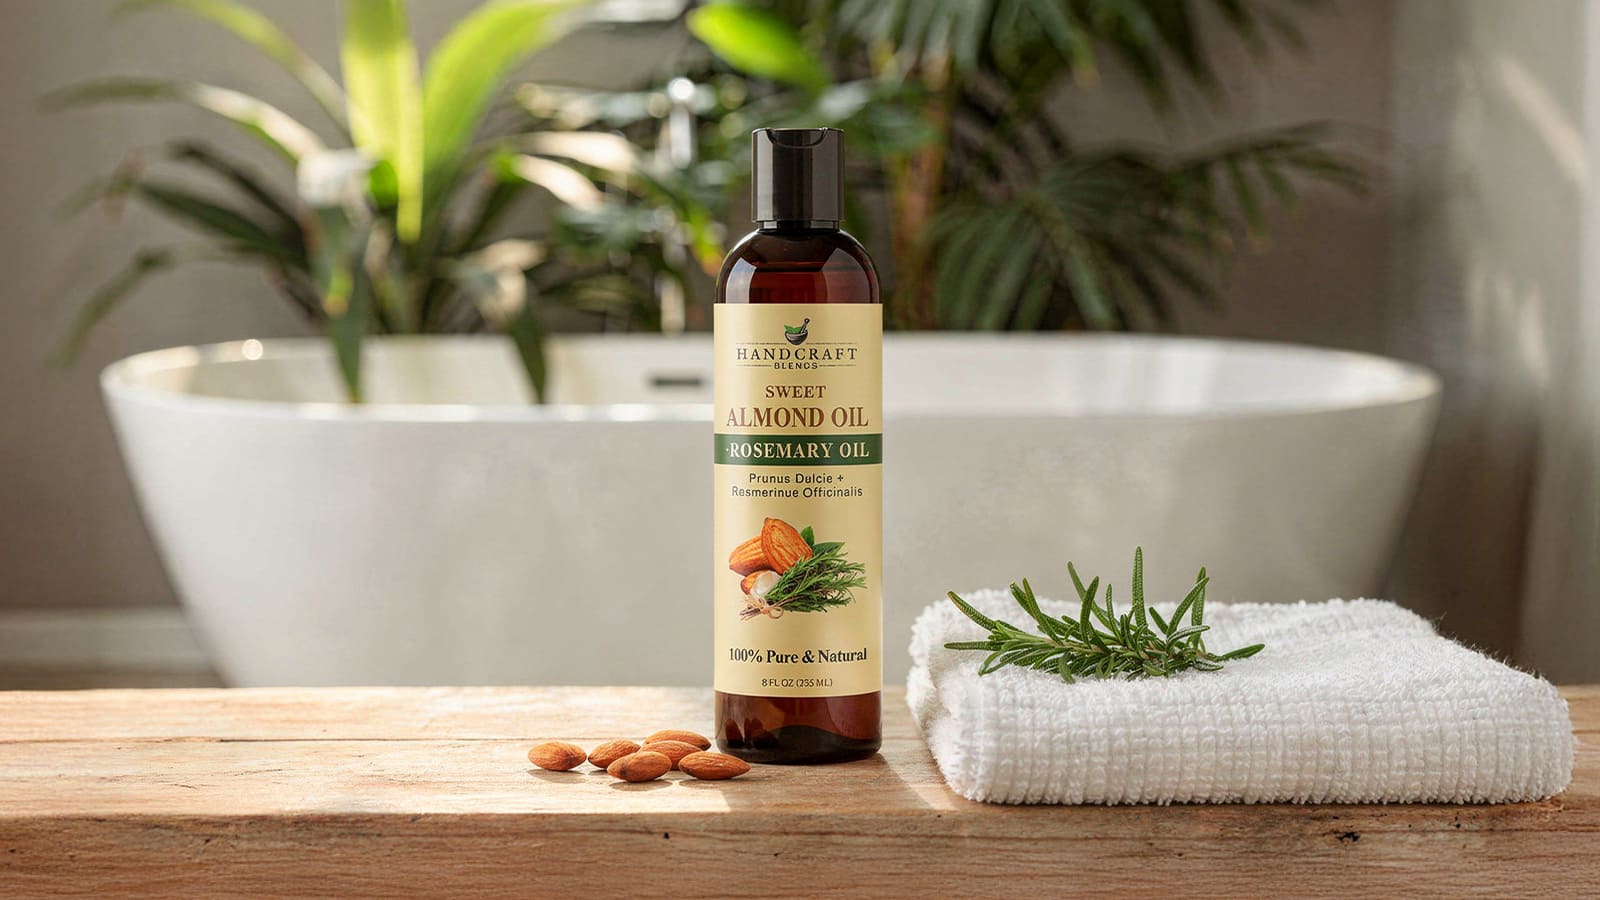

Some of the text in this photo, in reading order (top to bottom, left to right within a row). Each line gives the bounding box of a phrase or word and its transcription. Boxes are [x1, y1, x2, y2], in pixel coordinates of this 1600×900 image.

[736, 348, 858, 361] HANDCRAFT
[765, 385, 827, 399] SWEET
[726, 406, 869, 428] ALMOND OIL
[729, 442, 870, 459] ROSEMARY OIL
[749, 473, 791, 484] Prunus
[802, 486, 863, 498] Officinalis
[729, 647, 867, 664] 100% Pure & Natural
[761, 678, 768, 687] 8
[769, 678, 779, 687] FL
[781, 678, 794, 688] OZ
